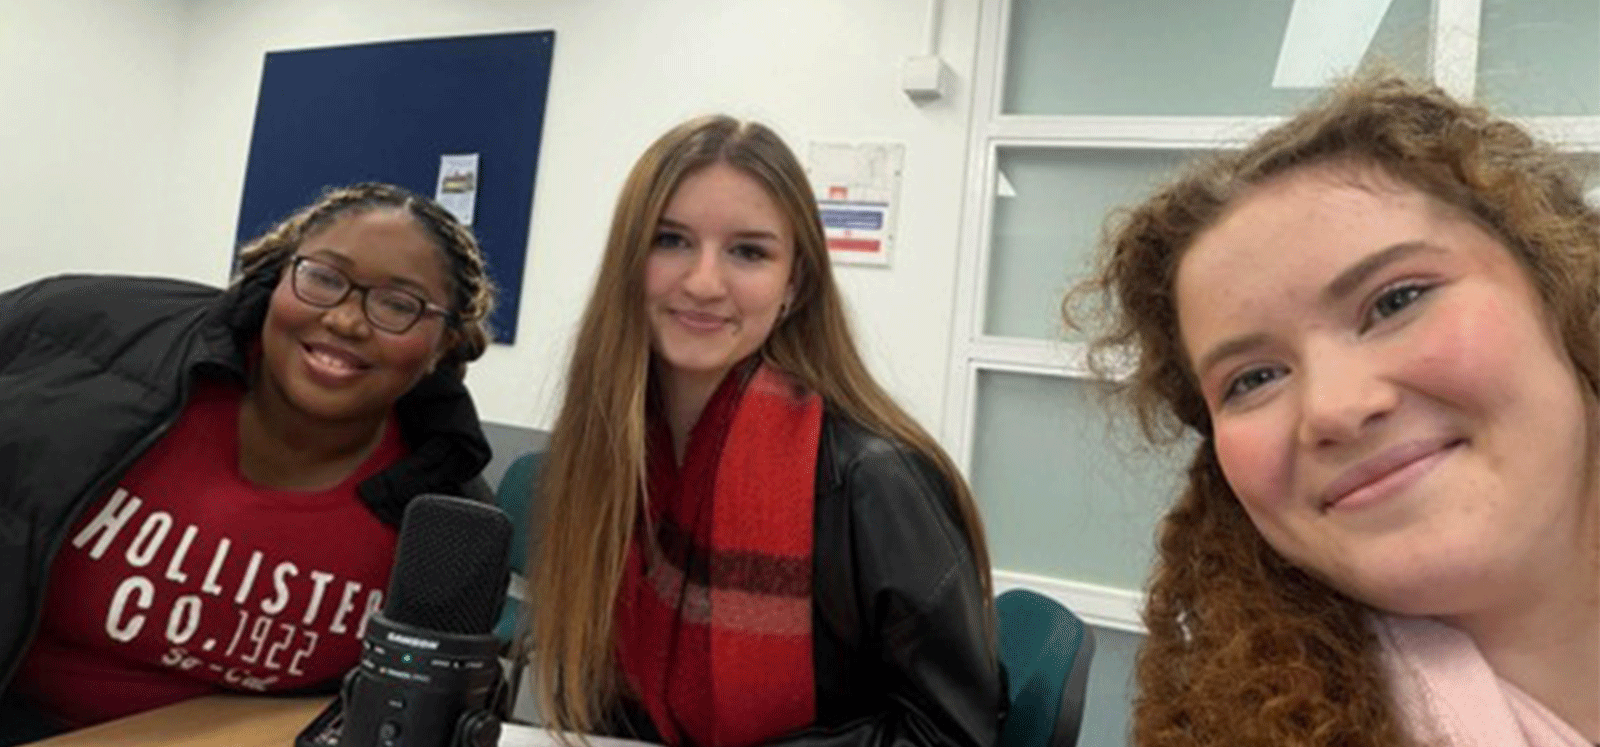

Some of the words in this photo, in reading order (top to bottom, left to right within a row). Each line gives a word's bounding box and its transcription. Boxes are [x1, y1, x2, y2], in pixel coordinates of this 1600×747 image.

[72, 488, 384, 640] HOLLISTER
[105, 576, 217, 651] CO.
[226, 610, 318, 676] 1922
